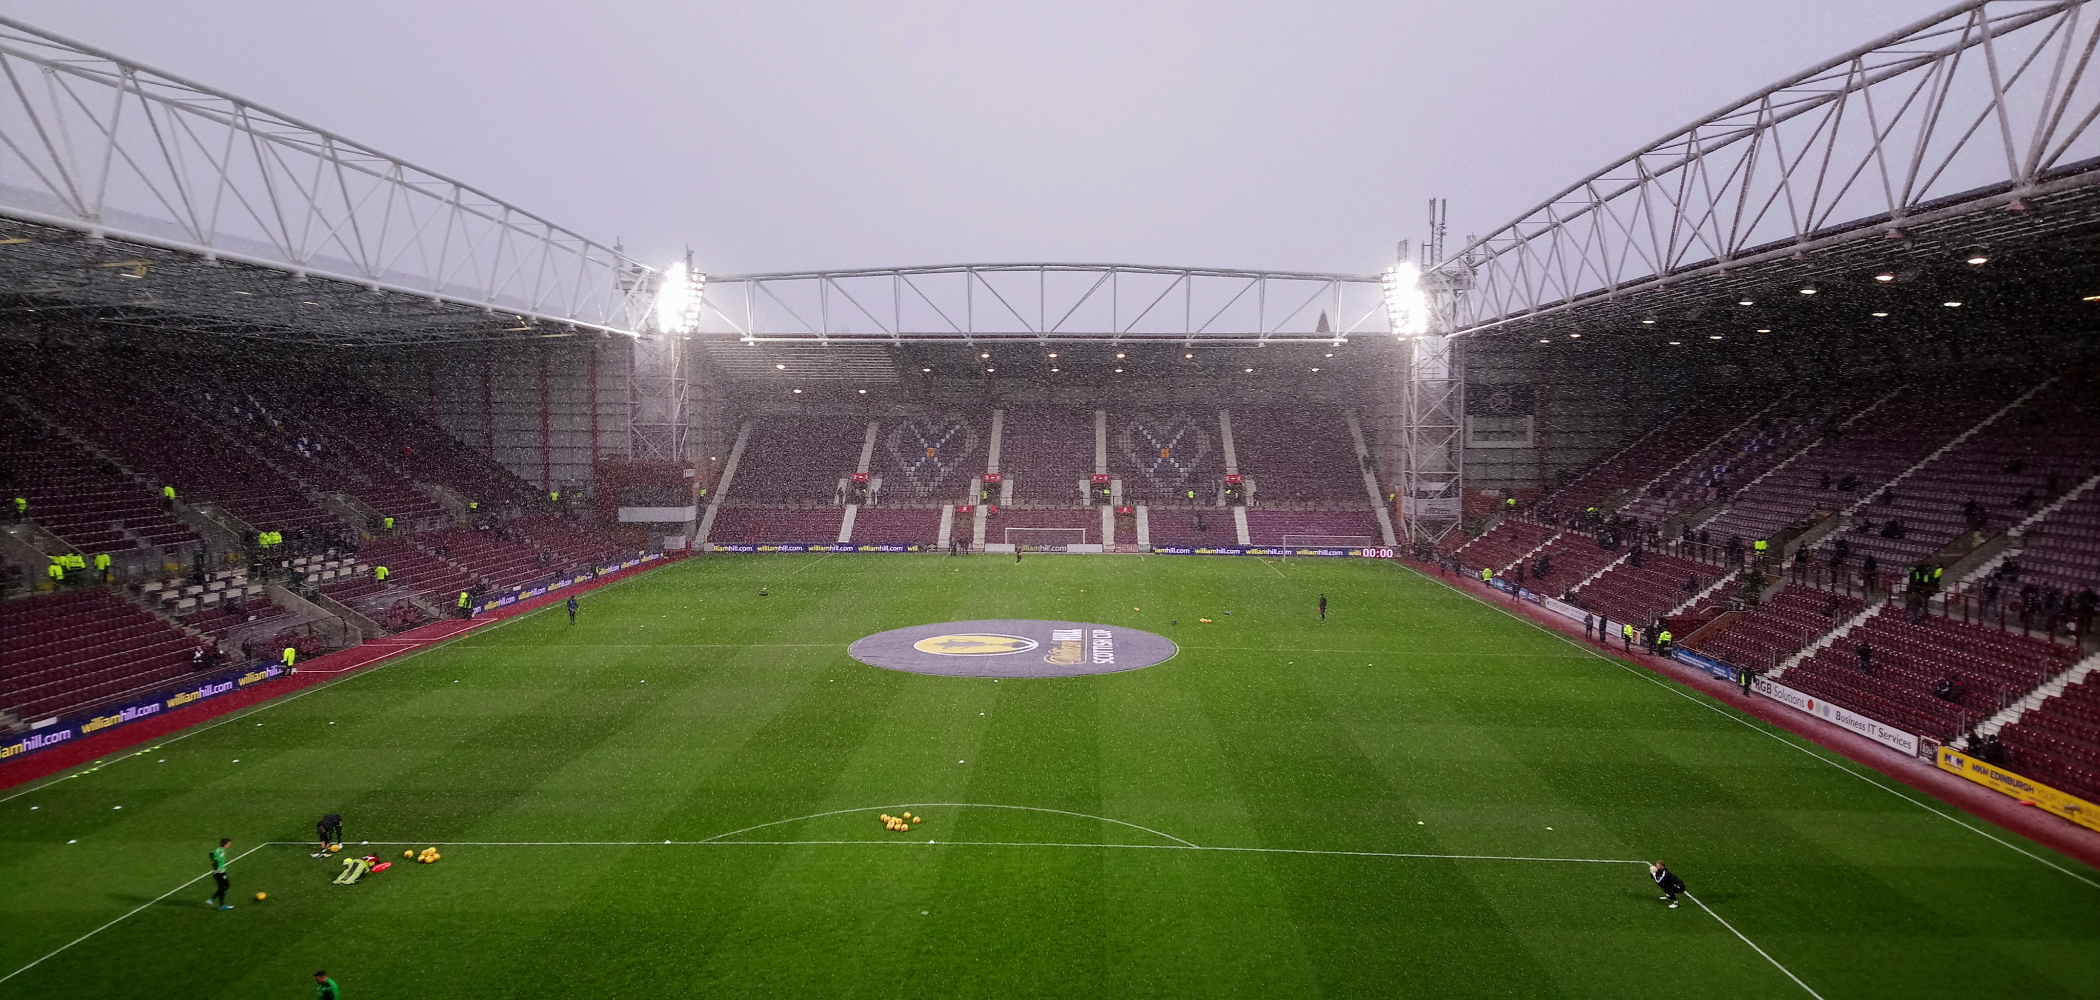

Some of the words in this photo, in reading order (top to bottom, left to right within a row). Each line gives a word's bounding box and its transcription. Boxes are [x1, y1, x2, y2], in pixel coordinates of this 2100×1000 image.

[1363, 548, 1394, 558] 00:00
[1092, 639, 1115, 665] SCOTTISH
[166, 681, 233, 708] williamhill.com
[1755, 677, 1772, 695] RGB
[1773, 685, 1805, 708] Solutions
[81, 702, 160, 734] williamhill.com
[1835, 710, 1866, 731] Business
[1867, 723, 1877, 735] IT
[1878, 727, 1912, 750] Services
[1972, 763, 1989, 778] MKM
[1990, 771, 2035, 794] EDINBURGH
